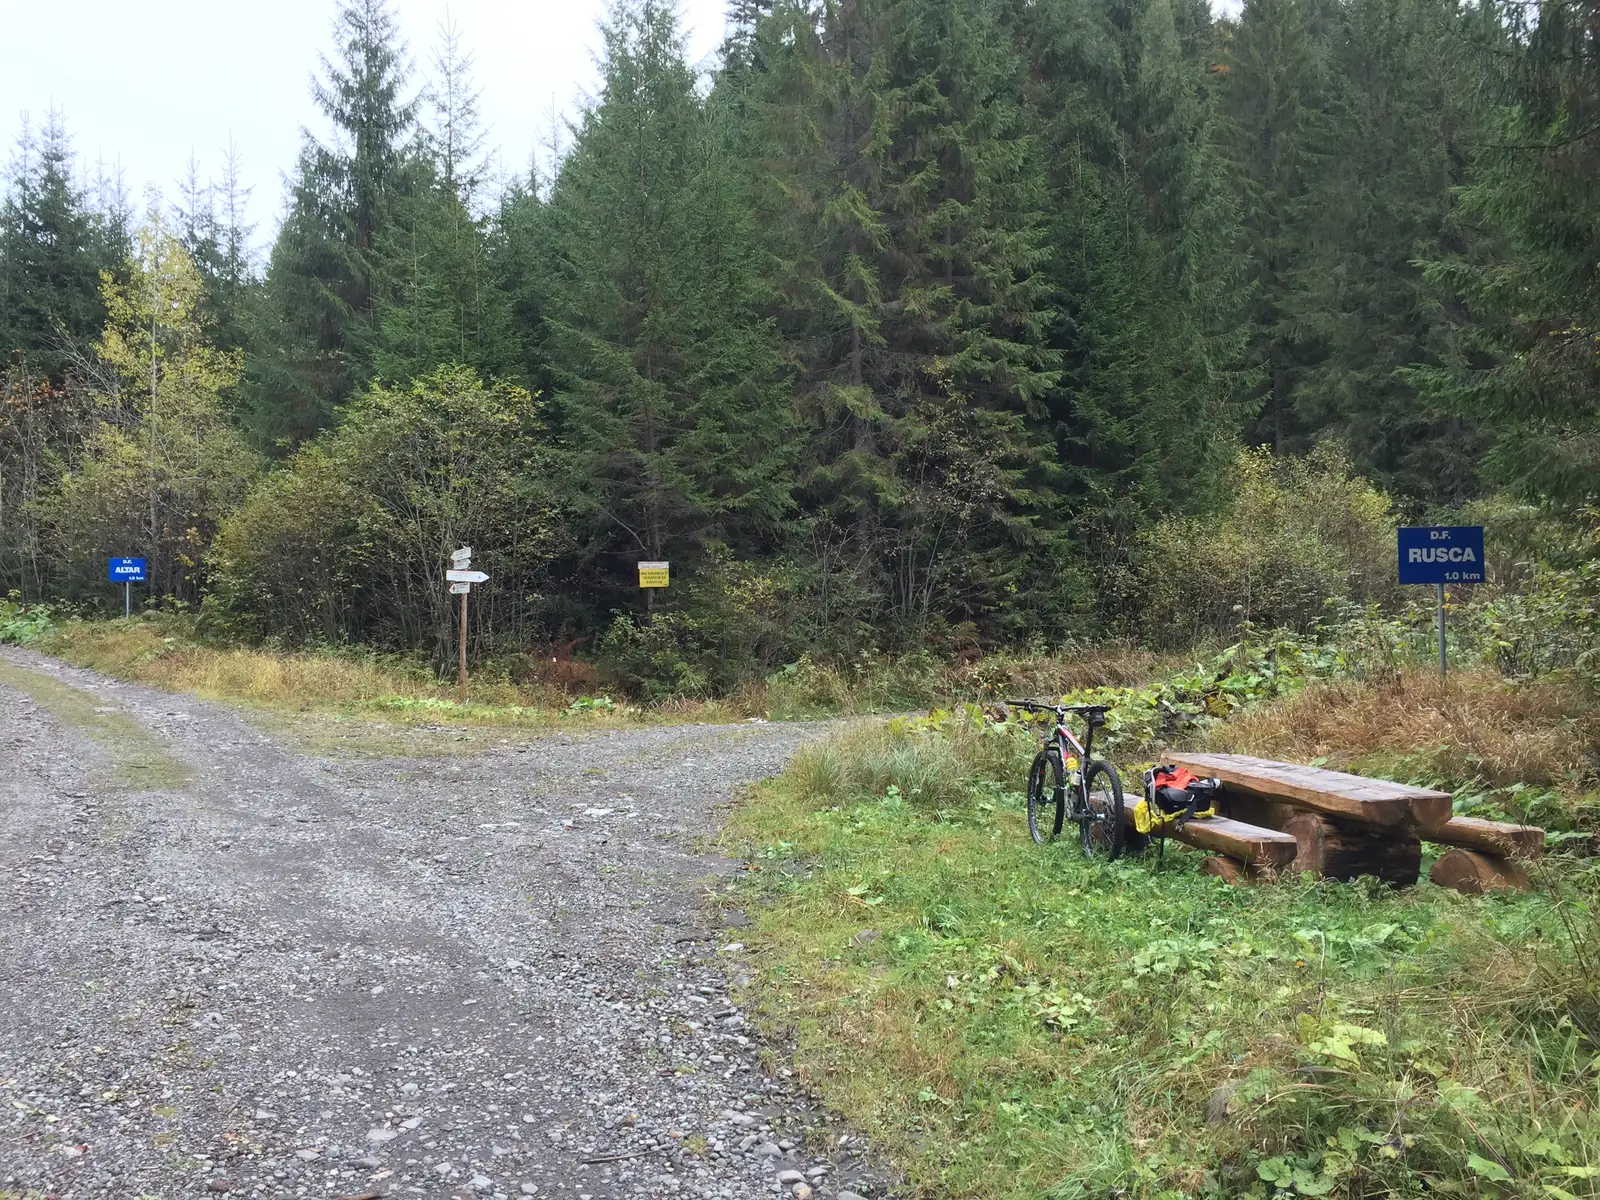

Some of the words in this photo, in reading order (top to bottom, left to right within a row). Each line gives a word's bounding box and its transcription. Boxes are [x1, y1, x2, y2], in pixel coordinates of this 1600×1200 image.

[1430, 531, 1451, 540] D.F.
[1408, 547, 1476, 563] RUSCA
[115, 566, 140, 574] ALTAR
[1444, 572, 1459, 580] 1.0
[1462, 572, 1480, 580] km
